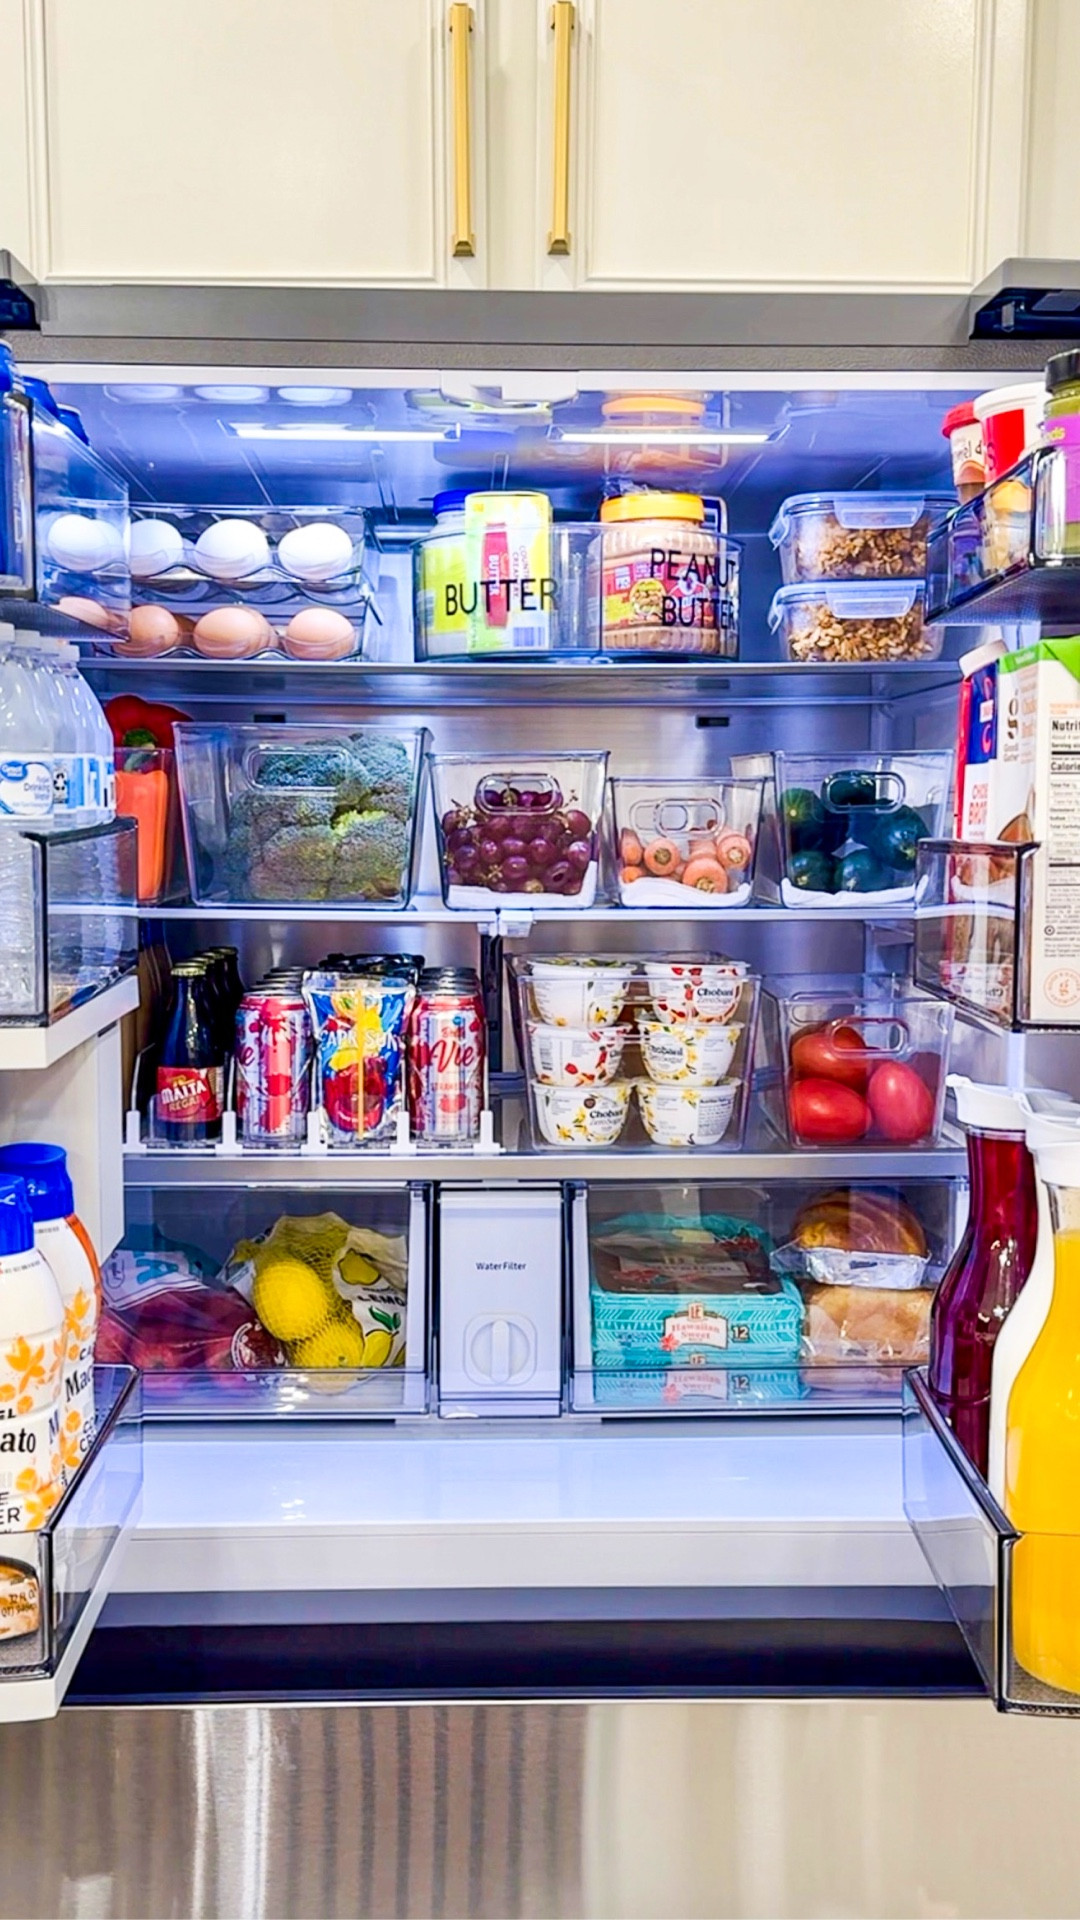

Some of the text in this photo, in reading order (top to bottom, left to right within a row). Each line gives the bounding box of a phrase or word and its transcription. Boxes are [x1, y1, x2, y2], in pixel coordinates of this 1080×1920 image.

[650, 548, 736, 587] PEANUT
[445, 578, 559, 616] BUTTER
[661, 596, 735, 629] BUTTER
[430, 1039, 474, 1073] Vie
[161, 1080, 207, 1104] MALTA
[671, 1323, 720, 1334] Hawaiian
[681, 1332, 711, 1340] Sweet
[733, 1326, 749, 1339] 12
[733, 1376, 749, 1389] 12
